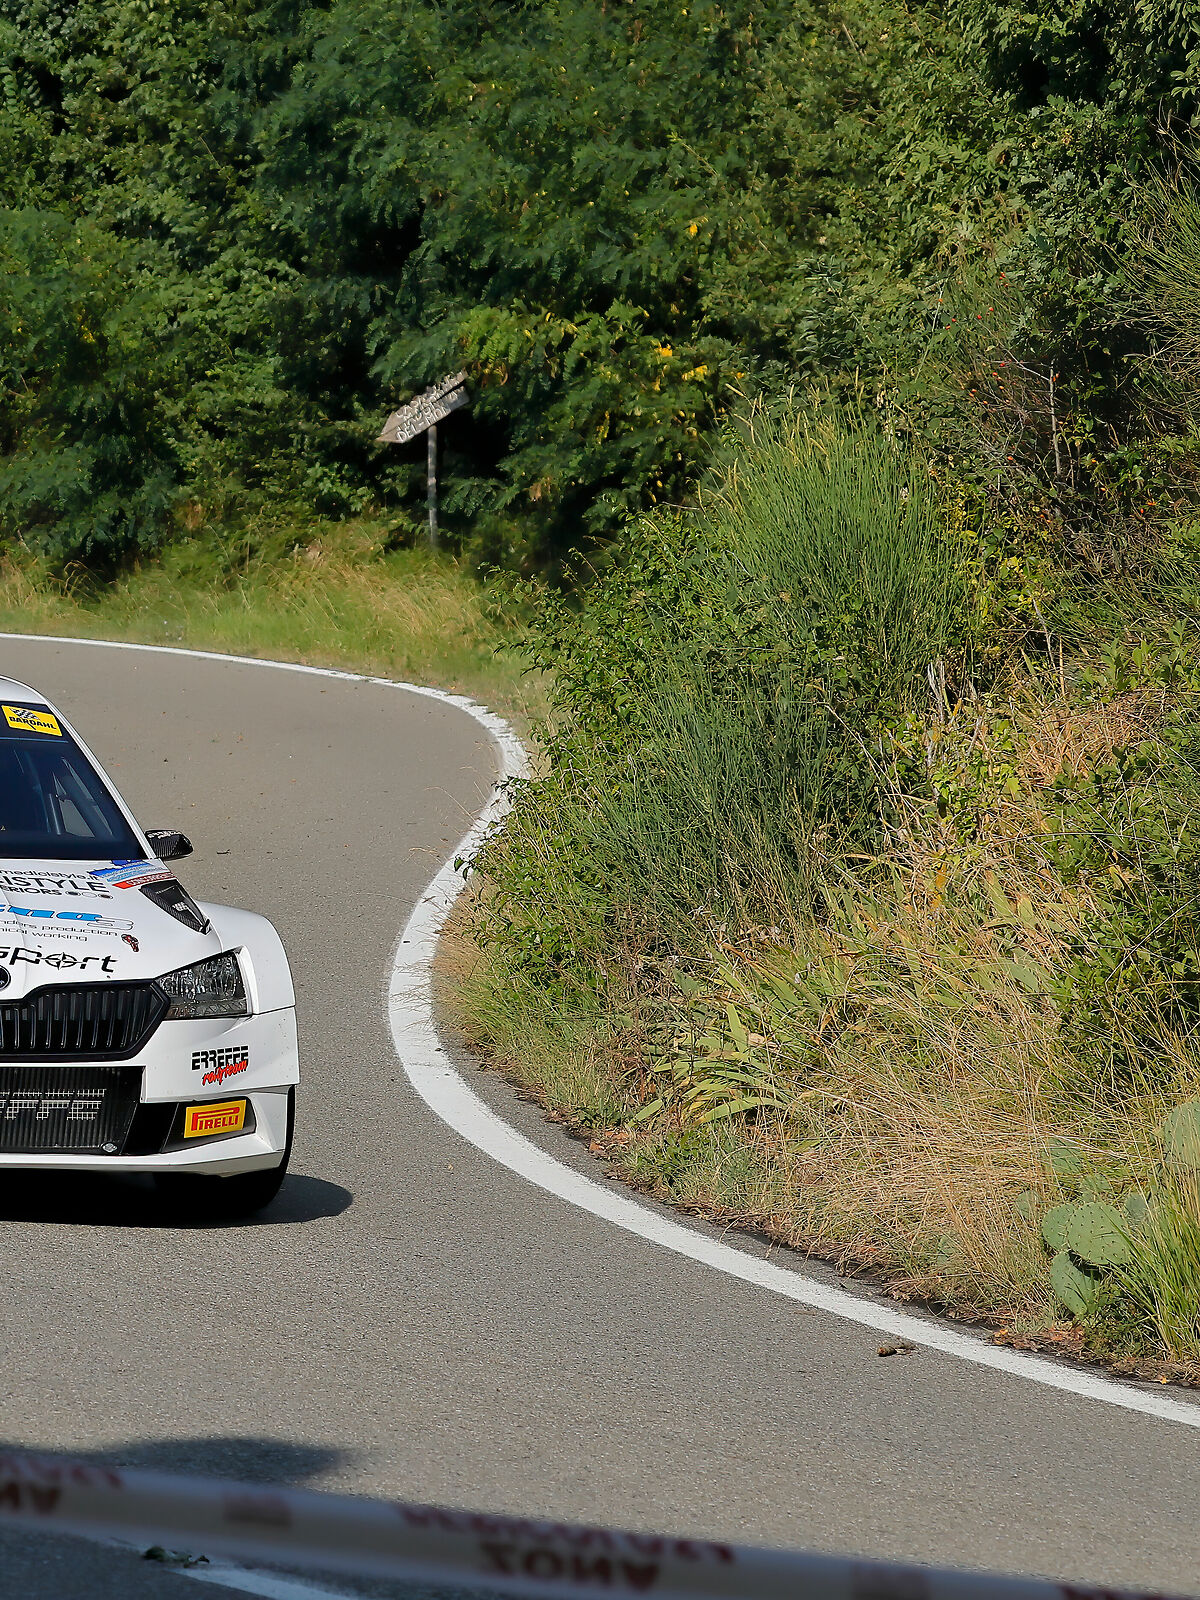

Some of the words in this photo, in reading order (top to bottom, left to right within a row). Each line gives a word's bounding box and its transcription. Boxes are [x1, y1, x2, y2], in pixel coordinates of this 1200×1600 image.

[8, 716, 57, 730] BARDAHL
[41, 924, 119, 938] production
[191, 1045, 249, 1071] ERREFFE
[191, 1106, 240, 1132] PIRELLI
